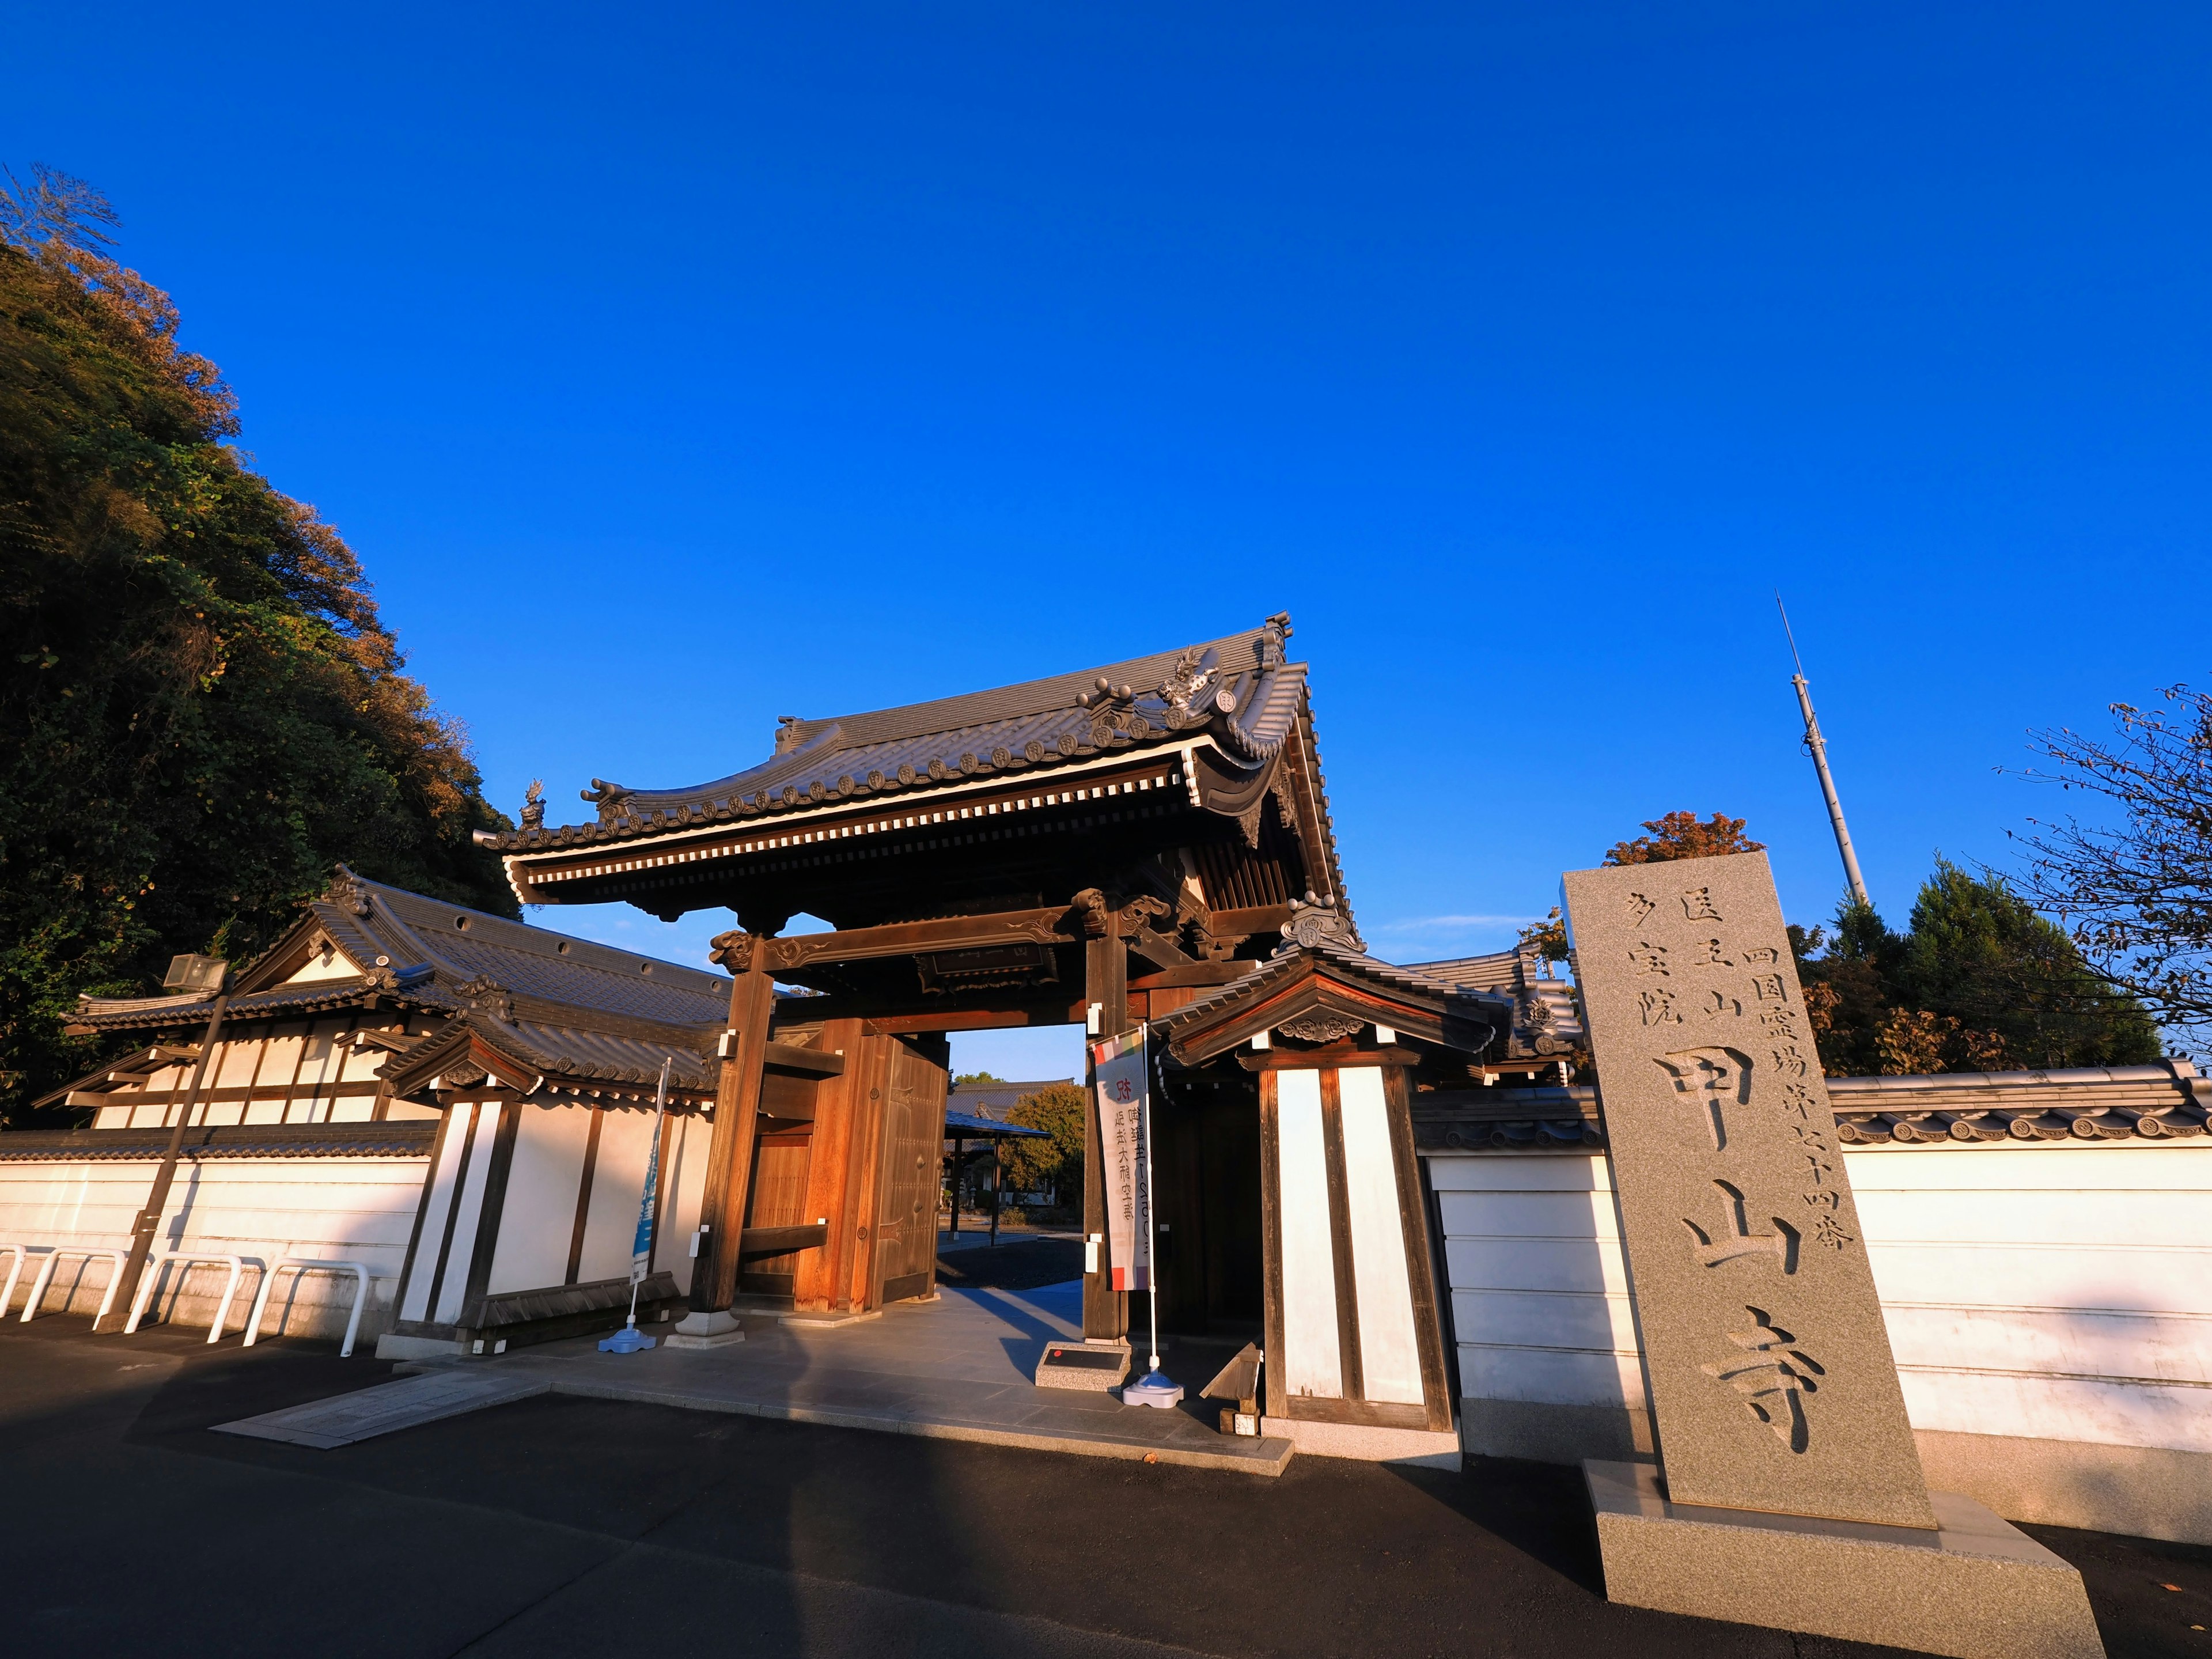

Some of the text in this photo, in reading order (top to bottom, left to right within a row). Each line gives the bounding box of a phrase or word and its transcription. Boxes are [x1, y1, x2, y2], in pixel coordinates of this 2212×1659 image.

[1626, 892, 1683, 1027] 多宝院
[1680, 887, 1741, 1021] 医王山
[1652, 1046, 1825, 1454] 甲山寺
